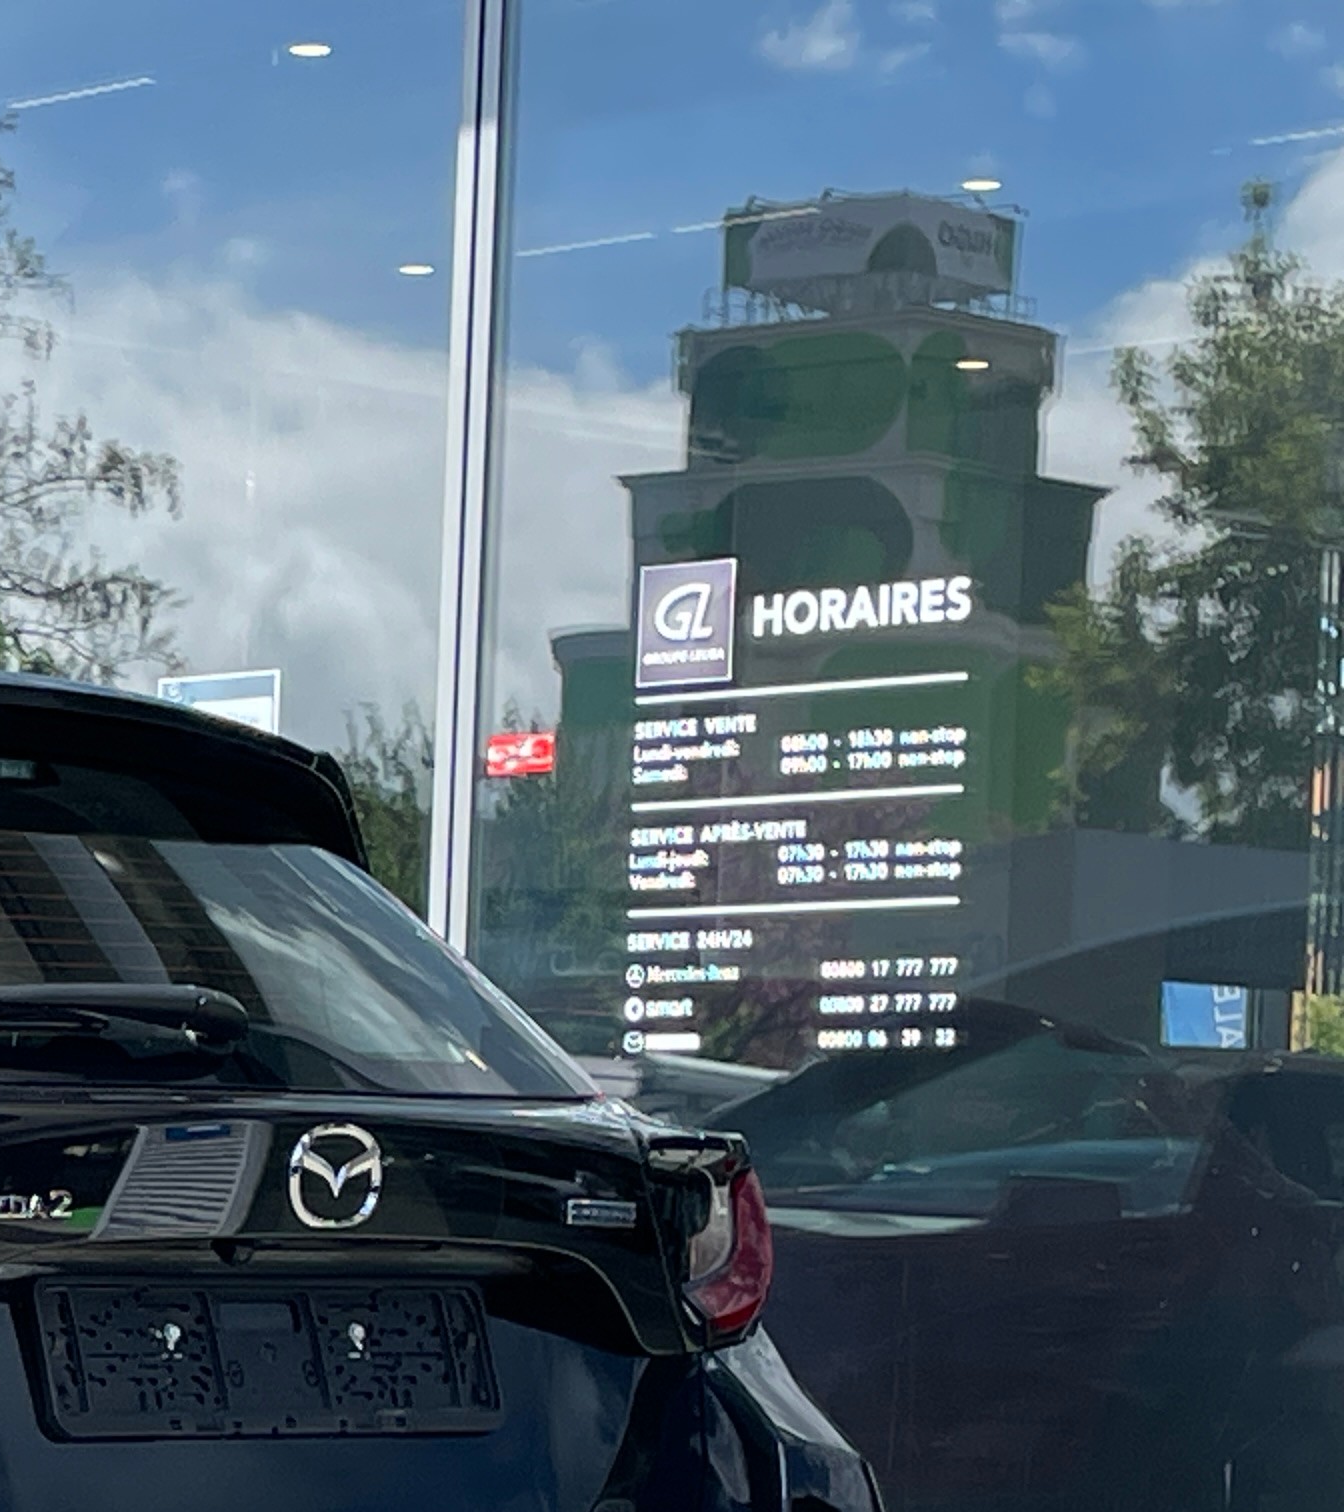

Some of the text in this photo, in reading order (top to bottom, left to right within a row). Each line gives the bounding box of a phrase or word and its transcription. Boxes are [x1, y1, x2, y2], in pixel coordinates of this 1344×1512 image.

[752, 575, 972, 637] HORAIRES
[634, 713, 757, 741] SERVICE VENTE
[630, 820, 807, 847] SERVICE APRÈS-VENTE
[777, 843, 825, 863] 07h30
[845, 839, 889, 859] 17h30
[777, 865, 825, 885] 07h30
[843, 861, 889, 881] 17h30
[627, 929, 753, 952] SERVICE 24H/24
[871, 959, 890, 977] 17
[896, 958, 924, 977] 777
[929, 957, 958, 975] 777
[869, 994, 889, 1013] 27
[895, 993, 922, 1012] 777
[929, 993, 957, 1011] 777
